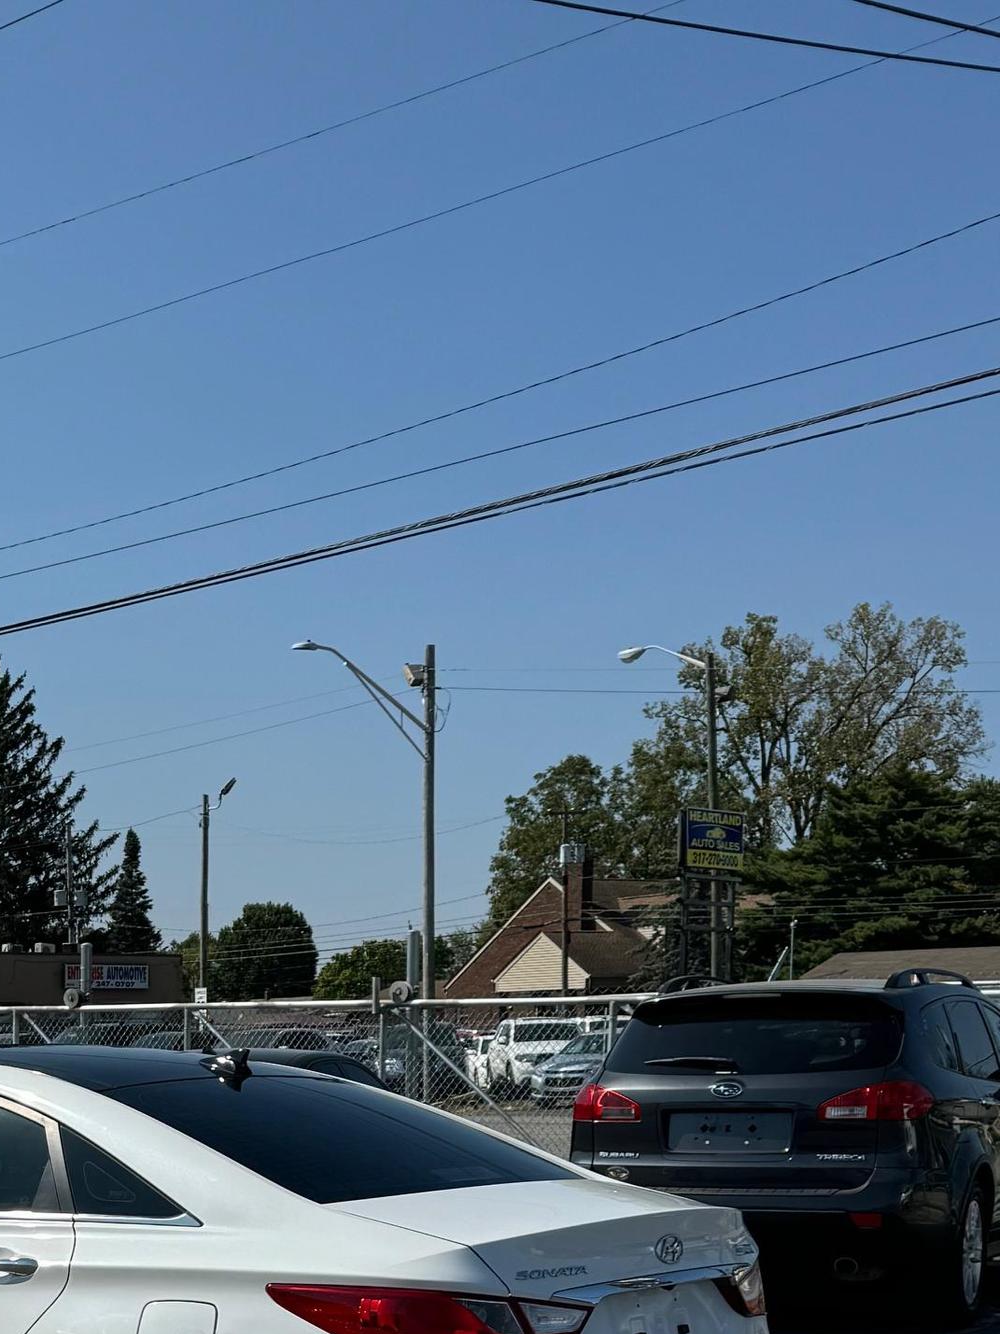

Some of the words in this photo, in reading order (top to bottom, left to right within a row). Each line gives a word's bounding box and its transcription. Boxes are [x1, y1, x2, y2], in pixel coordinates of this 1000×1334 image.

[690, 810, 741, 826] HEARTLAND
[691, 838, 714, 848] AUTO
[716, 840, 740, 851] SALES
[106, 966, 147, 981] AUTOMOTIVE
[515, 1266, 588, 1280] SONATA
